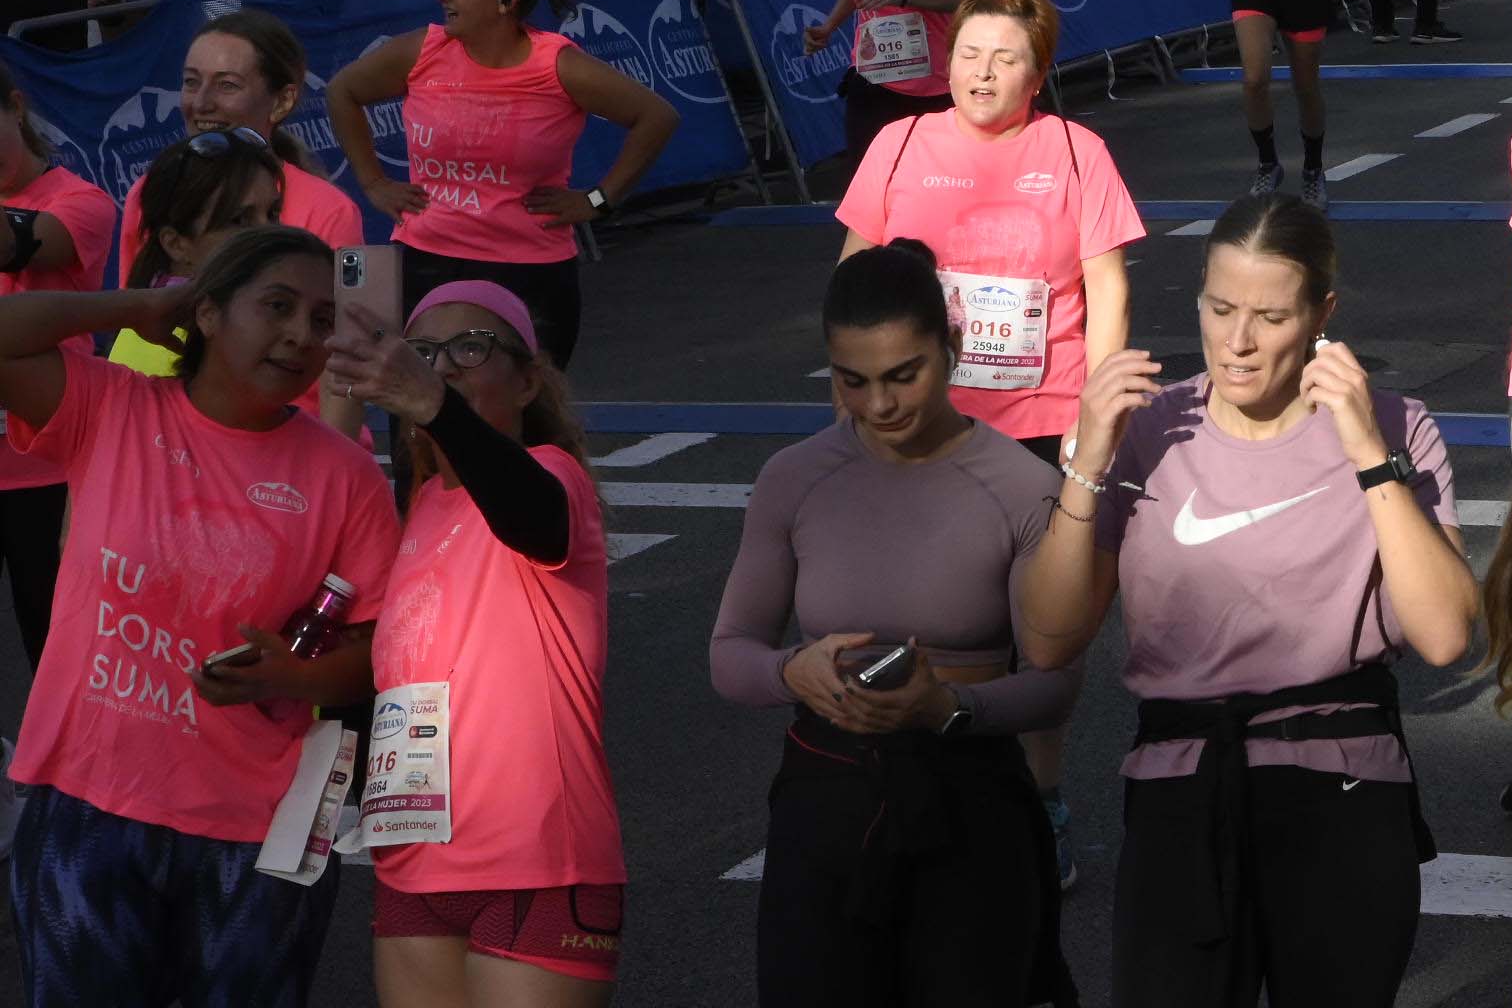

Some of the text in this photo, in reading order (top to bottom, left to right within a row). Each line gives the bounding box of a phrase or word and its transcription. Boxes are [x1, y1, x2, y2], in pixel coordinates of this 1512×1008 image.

[878, 41, 903, 53] 016
[412, 122, 433, 148] TU
[413, 153, 511, 185] DORSAL
[922, 175, 974, 189] OYSHO
[970, 293, 1017, 307] ASTURIANA
[970, 320, 1012, 338] 016
[972, 340, 1005, 352] 25948
[974, 355, 985, 363] DE
[996, 357, 1019, 365] MUJER
[1002, 371, 1035, 382] Santander
[101, 547, 146, 594] TU
[89, 654, 198, 725] SUMA
[410, 705, 438, 715] SUMA
[378, 798, 407, 809] MUJER
[411, 798, 432, 808] 2023
[385, 820, 438, 832] Santander
